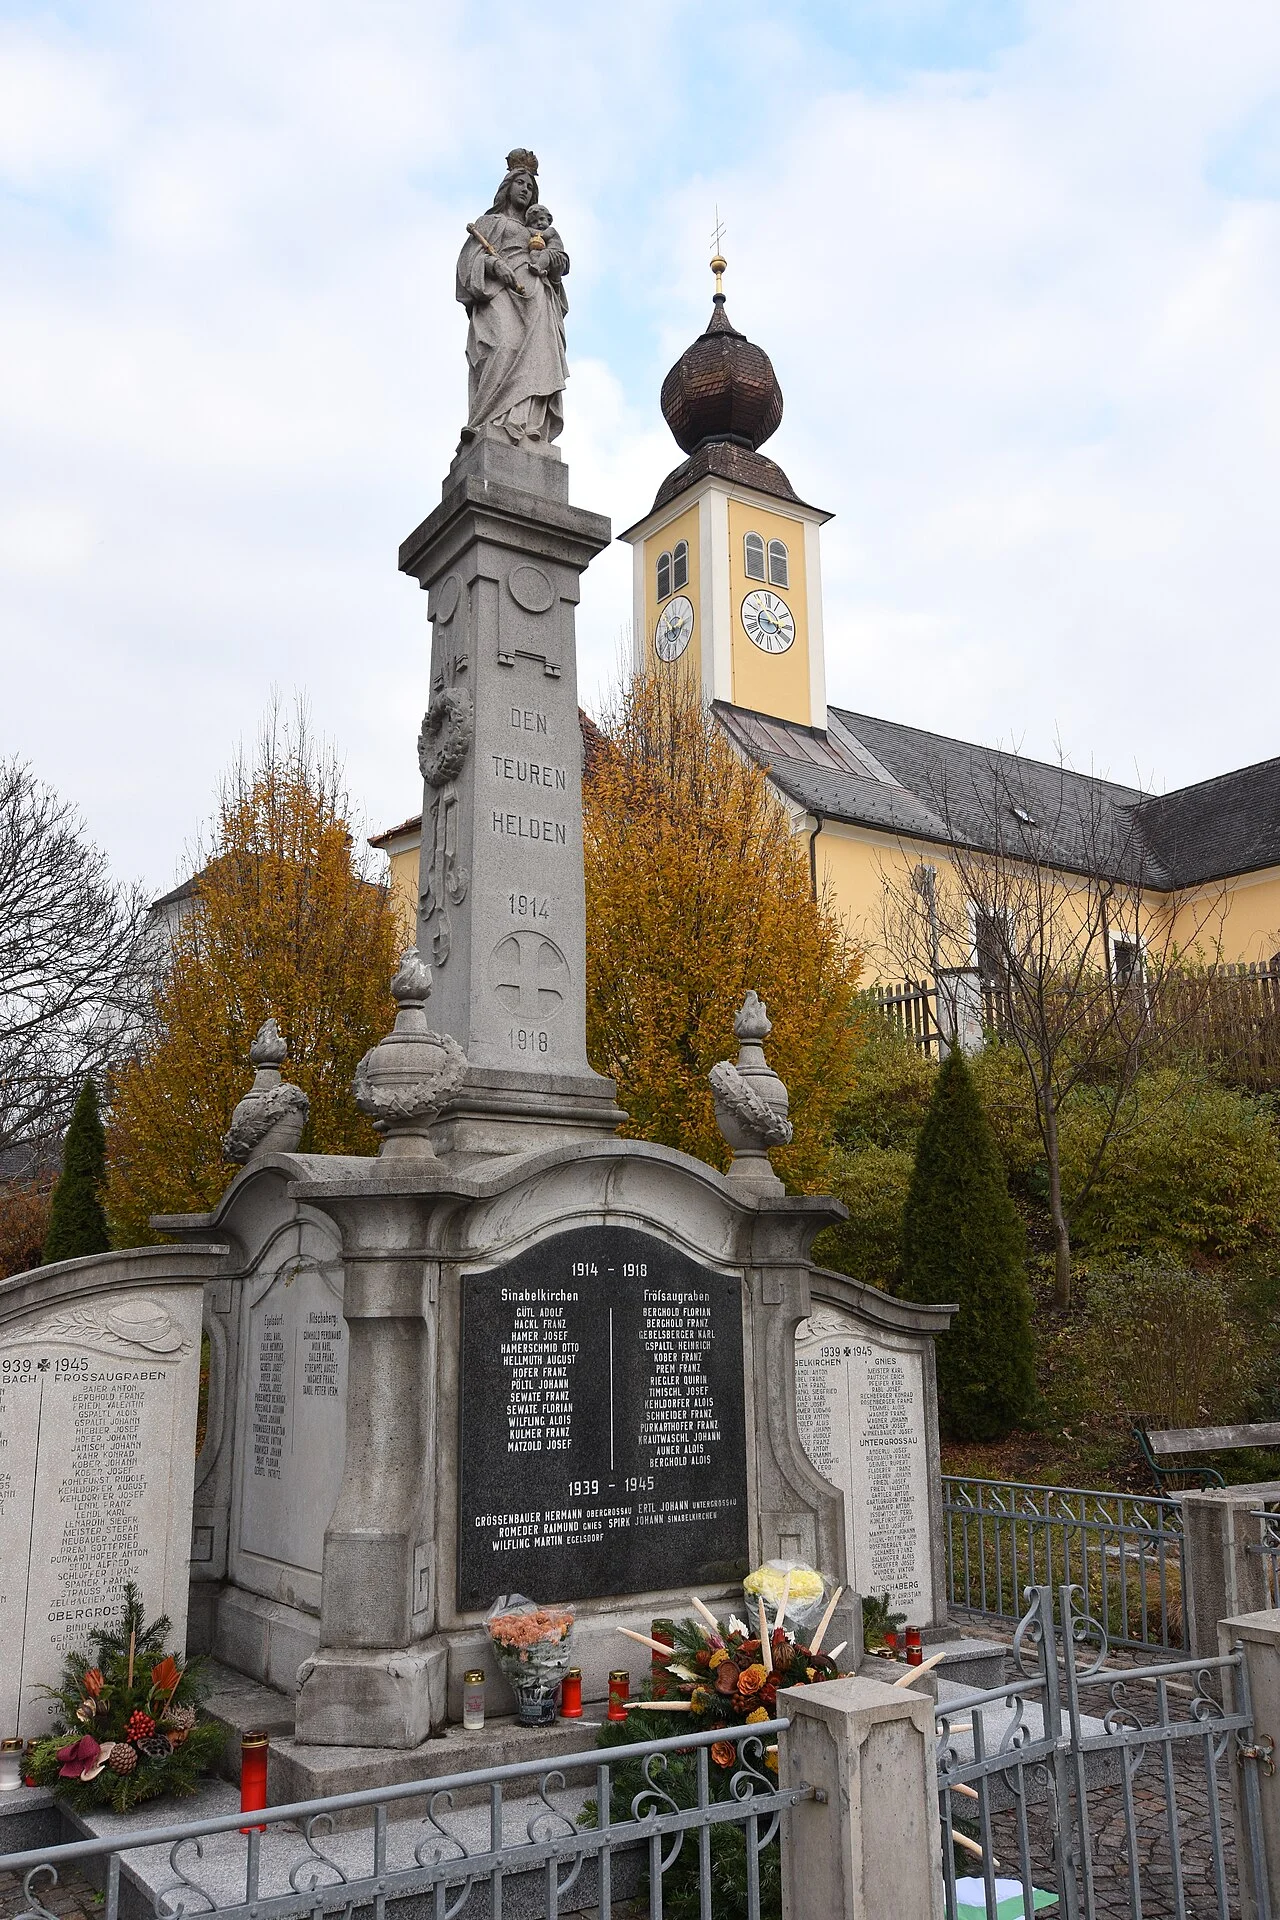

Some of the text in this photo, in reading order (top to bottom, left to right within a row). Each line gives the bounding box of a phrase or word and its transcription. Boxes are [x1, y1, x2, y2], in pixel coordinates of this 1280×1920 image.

[511, 708, 547, 735] DEN
[492, 756, 566, 790] TEUREN
[493, 811, 566, 845] HELDEN
[509, 894, 550, 919] 1914
[508, 1028, 548, 1052] 1918
[572, 1263, 598, 1277] 1914
[622, 1263, 648, 1277] 1918
[501, 1288, 578, 1301] Sinabelkirchen
[516, 1306, 564, 1317] GÜTL ADOLF
[642, 1308, 711, 1316] BERGHOLD FLORIAN
[514, 1320, 566, 1329] HACKL FRANZ
[646, 1318, 708, 1328] BERGHOLD FRANZ
[512, 1331, 568, 1341] HAMER JOSEF
[638, 1330, 716, 1340] GEBELSBERGER KARL
[500, 1343, 580, 1354] HAMERSCHMID OTTO
[645, 1340, 710, 1350] GSPALTL HEINRICH
[654, 1352, 702, 1362] KOBER FRANZ
[820, 1346, 872, 1357] 1939 1945
[1, 1358, 88, 1373] 939 1945
[504, 1354, 576, 1366] HELLMUTH AUGUST
[512, 1367, 567, 1378] HOFER FRANZ
[656, 1364, 700, 1374] PREM FRANZ
[2, 1374, 37, 1384] BACH
[511, 1379, 568, 1390] PÖLTL JOHANN
[650, 1375, 707, 1386] RIEGLER QUIRIN
[110, 1384, 137, 1392] ANTON
[648, 1386, 708, 1397] TIMISCHL JOSEF
[119, 1392, 145, 1400] FRANZ
[510, 1391, 569, 1402] SEWATE FRANZ
[506, 1403, 572, 1415] SEWATE FLORIAN
[644, 1398, 714, 1409] KEHLDORFER ALOIS
[646, 1409, 712, 1420] SCHNEIDER FRANZ
[508, 1415, 571, 1428] WILFLING ALOIS
[640, 1420, 718, 1432] PURKARTHOFER FRANZ
[114, 1426, 140, 1434] JOSEF
[510, 1427, 570, 1440] KULMER FRANZ
[106, 1434, 138, 1442] JOHANN
[638, 1432, 720, 1444] KRAUTWASCHL JOHANN
[860, 1437, 918, 1446] UNTERGROSSAU
[110, 1442, 142, 1450] JOHANN
[508, 1439, 572, 1452] MATZOLD JOSEF
[656, 1444, 704, 1456] AUNER ALOIS
[77, 1450, 134, 1460] KAHR KONRAD
[105, 1458, 138, 1467] JOHANN
[650, 1455, 711, 1468] BERGHOLD ALOIS
[107, 1467, 134, 1475] JOSEF
[115, 1474, 145, 1482] RUDOLF
[117, 1482, 148, 1491] AUGUST
[568, 1480, 598, 1496] 1939
[625, 1476, 654, 1492] 1945
[118, 1490, 145, 1499] JOSEF
[475, 1512, 540, 1527] GRÖSSENBAUER
[545, 1509, 582, 1522] HERMANN
[586, 1507, 632, 1518] OBERGROSSAU
[638, 1503, 656, 1514] ERTL
[660, 1500, 688, 1512] JOHANN
[64, 1524, 138, 1537] MEISTER STEFAN
[500, 1524, 538, 1538] ROMEDER
[544, 1522, 578, 1534] RAIMUND
[583, 1522, 602, 1530] GNIES
[608, 1517, 630, 1528] SPIRK
[634, 1514, 664, 1526] JOHANN
[62, 1533, 138, 1546] NEUBAUER JOSEF
[492, 1534, 604, 1552] WILFLING MARTIN EGELSDORF
[122, 1549, 148, 1558] ANTON
[870, 1581, 918, 1593] NITSCHABERG
[48, 1604, 128, 1622] OBERGROSS
